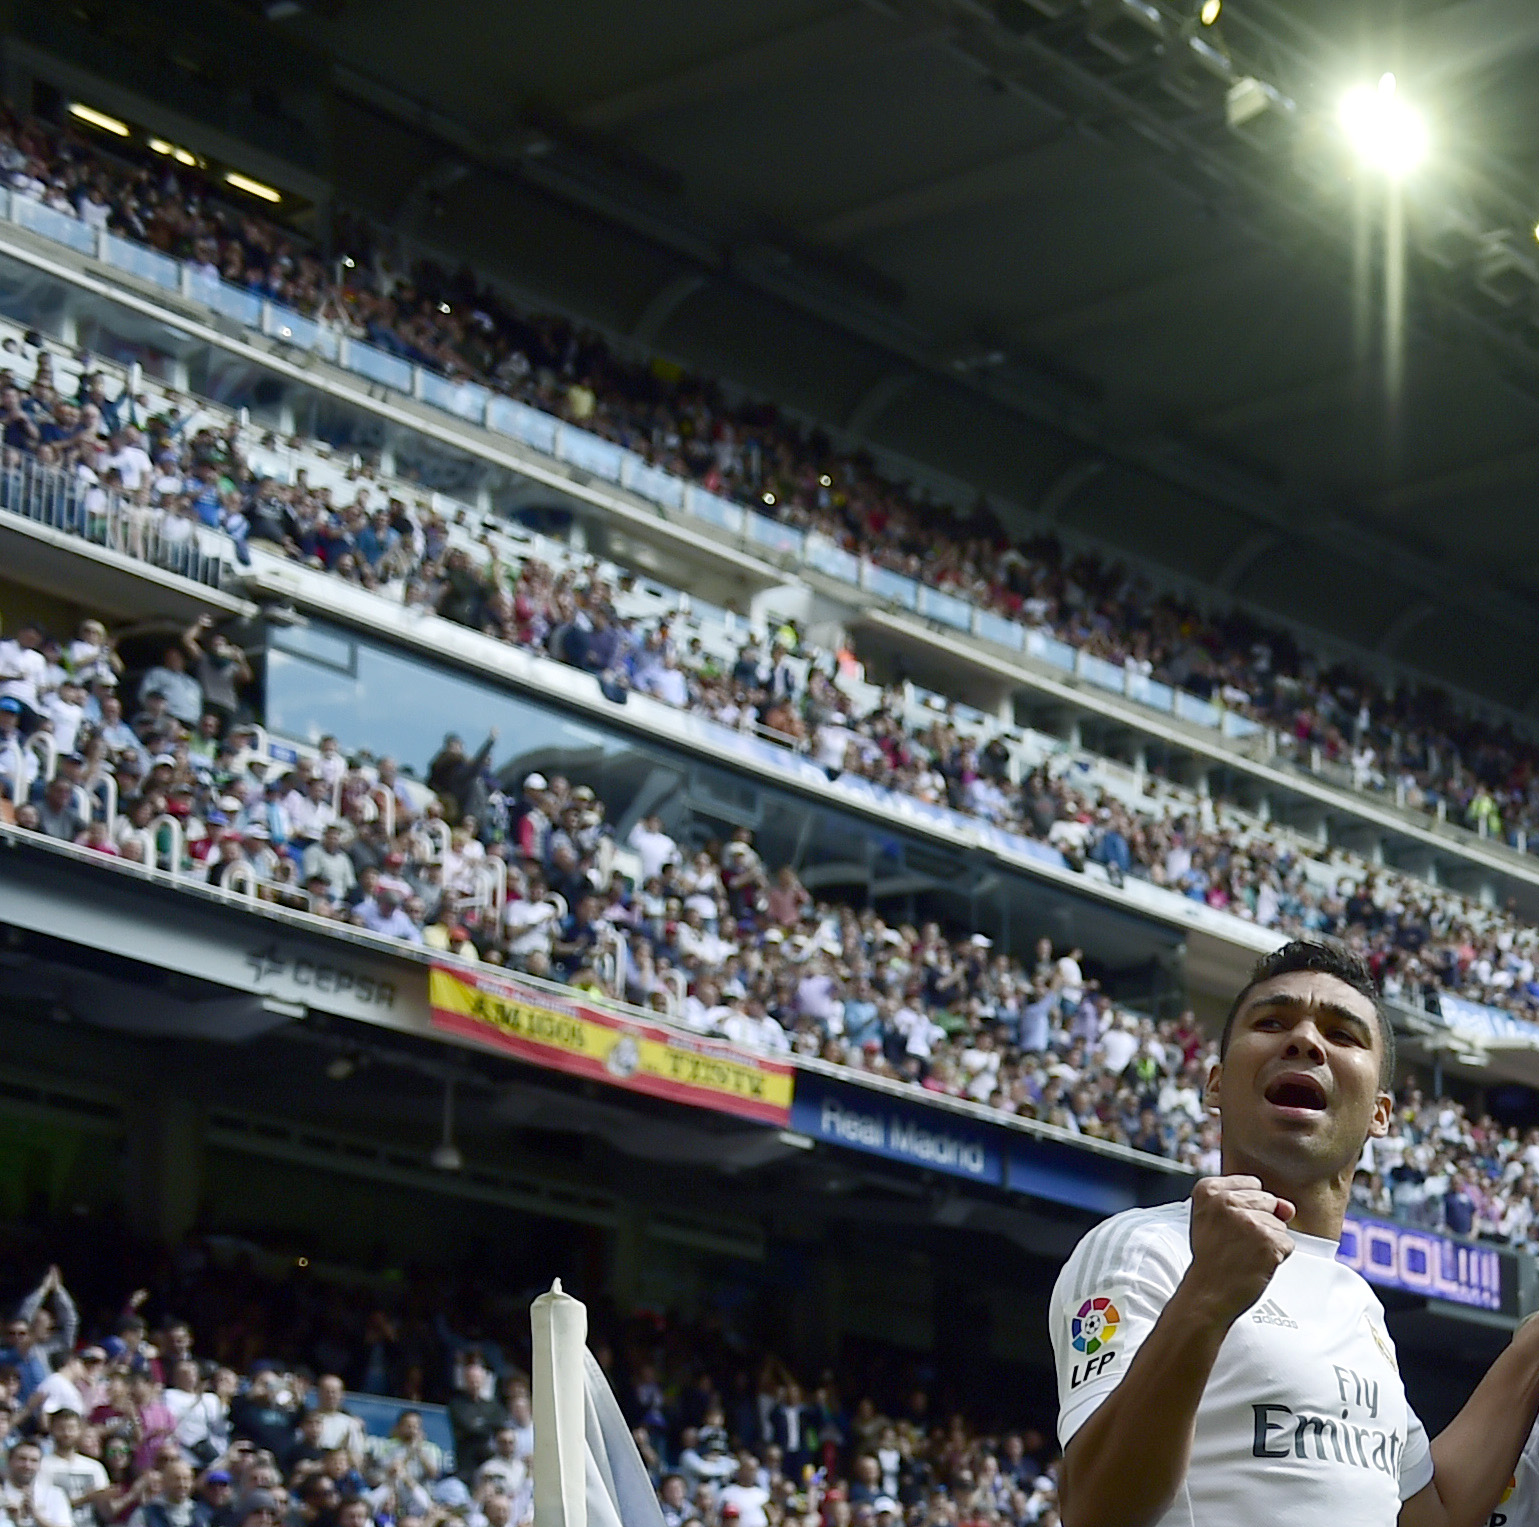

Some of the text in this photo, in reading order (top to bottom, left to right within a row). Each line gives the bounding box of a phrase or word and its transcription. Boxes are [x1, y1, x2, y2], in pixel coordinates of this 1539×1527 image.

[293, 959, 396, 1009] CEPSA
[820, 1102, 985, 1174] Real Madrid
[1252, 1315, 1299, 1330] adidas
[1071, 1351, 1116, 1389] LFP
[1333, 1364, 1379, 1419] Fly
[1252, 1404, 1404, 1482] Emirat
